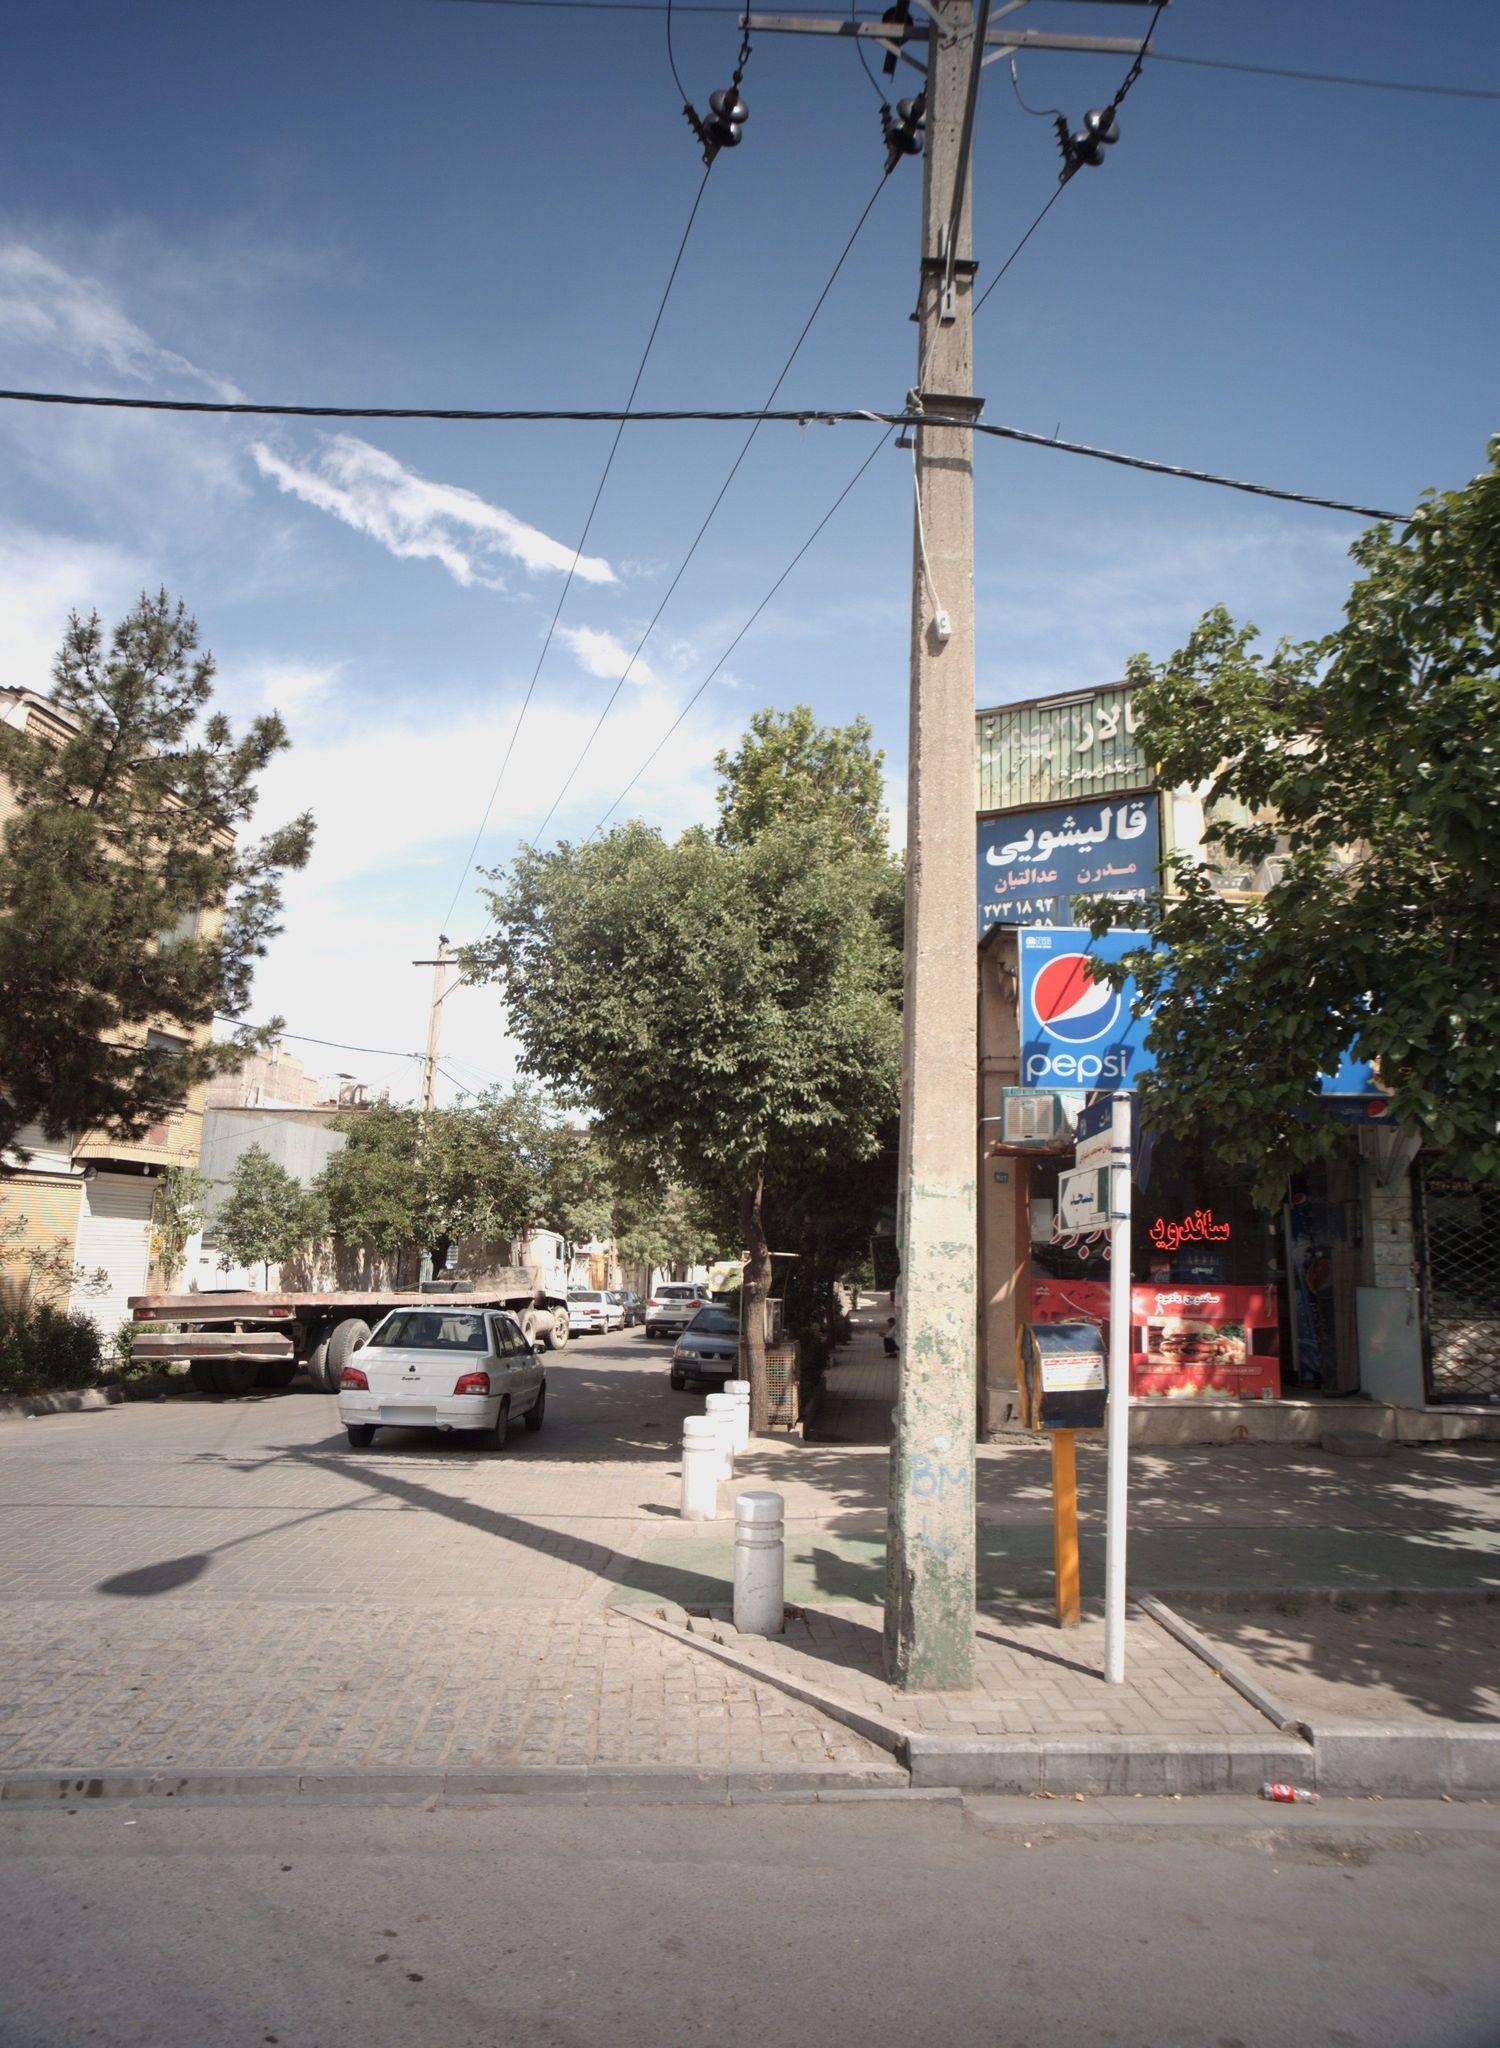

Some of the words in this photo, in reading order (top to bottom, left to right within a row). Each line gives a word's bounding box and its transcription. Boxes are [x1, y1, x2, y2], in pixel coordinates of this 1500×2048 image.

[986, 801, 1148, 866] قالیشویی
[1077, 862, 1137, 884] مدرن
[1026, 1049, 1127, 1082] pepsi
